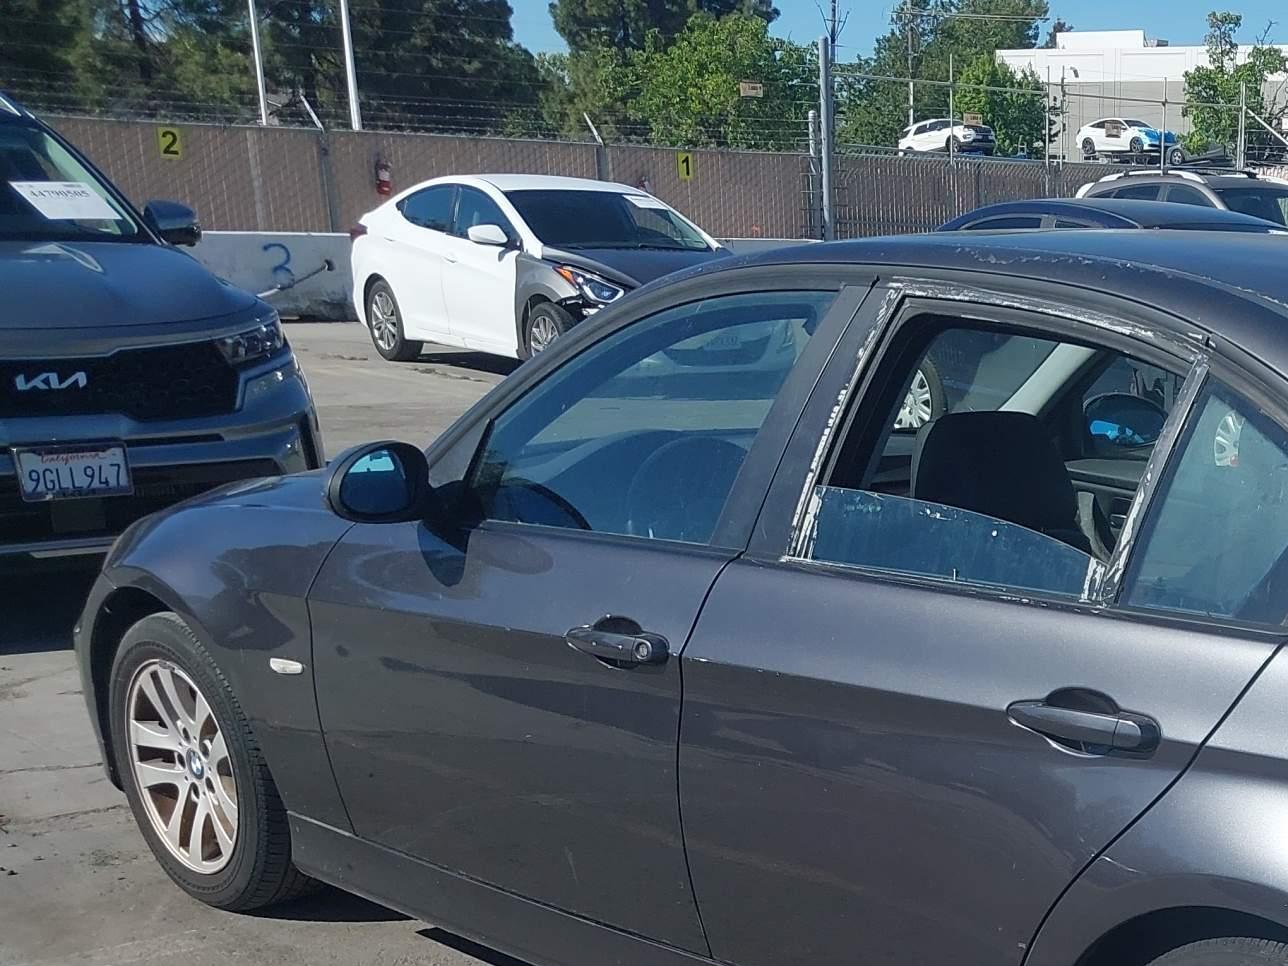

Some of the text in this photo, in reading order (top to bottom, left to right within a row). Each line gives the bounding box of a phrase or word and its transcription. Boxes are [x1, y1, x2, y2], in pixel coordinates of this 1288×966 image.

[161, 131, 179, 155] 2
[681, 155, 690, 177] 1
[15, 371, 88, 390] KIA
[28, 463, 121, 493] 9GLL947
